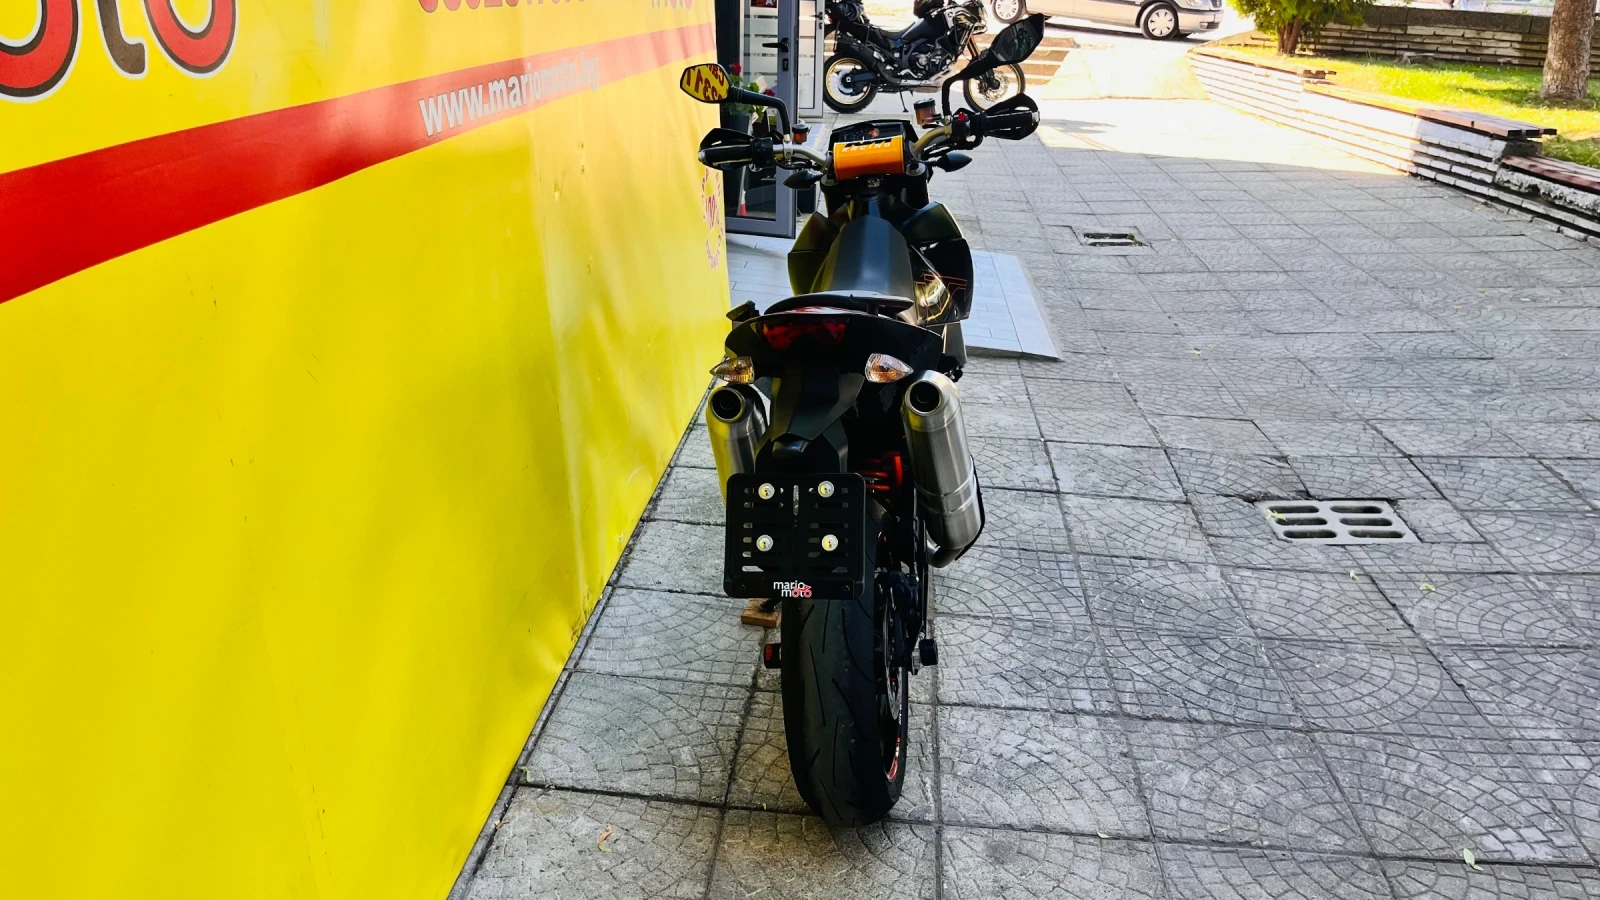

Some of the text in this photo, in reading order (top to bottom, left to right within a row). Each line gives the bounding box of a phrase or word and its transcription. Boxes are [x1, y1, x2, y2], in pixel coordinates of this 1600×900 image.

[419, 50, 598, 137] www.mariomoto.bg
[773, 580, 804, 589] mario
[781, 589, 812, 598] moto
